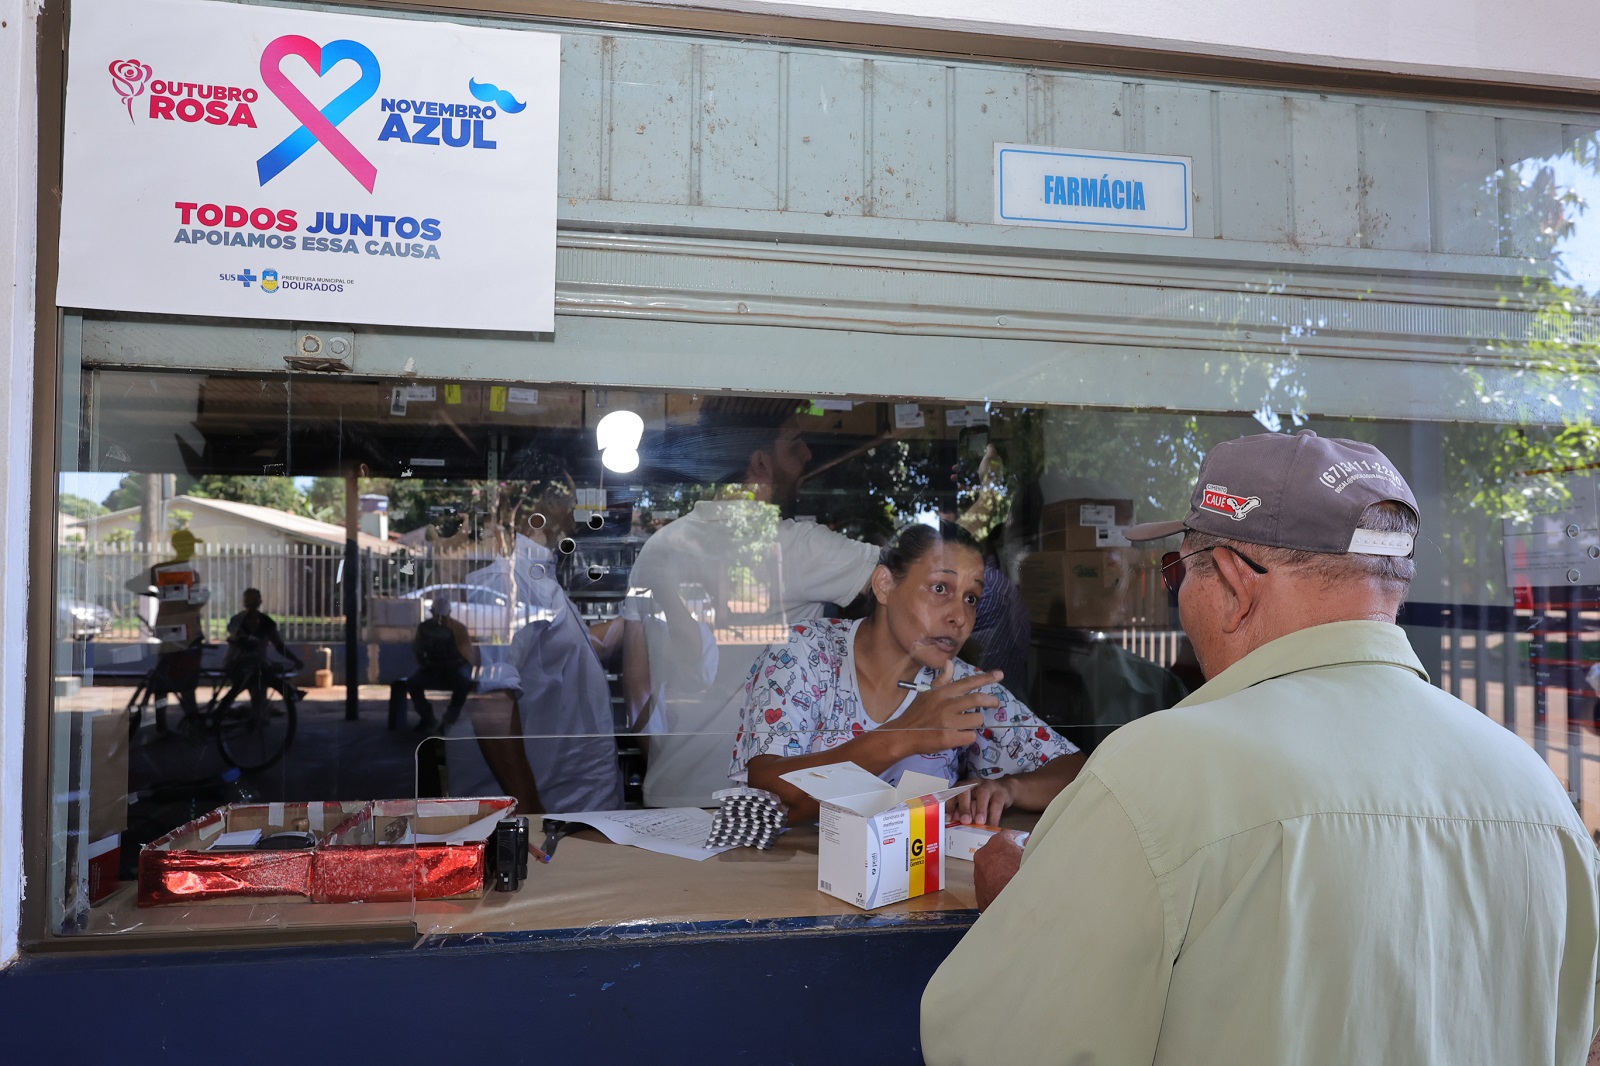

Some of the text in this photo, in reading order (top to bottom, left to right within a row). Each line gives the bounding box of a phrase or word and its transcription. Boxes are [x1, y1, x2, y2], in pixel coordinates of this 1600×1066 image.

[150, 79, 258, 103] OUTUBRO
[149, 94, 258, 128] ROSA
[381, 98, 497, 120] NOVEMBRO
[377, 113, 497, 149] AZUL
[1044, 173, 1146, 211] FARMÁCIA
[175, 201, 442, 241] TODOS JUNTOS
[174, 228, 441, 260] APOIAMOS ESSA CAUSA
[219, 273, 236, 281] SUS
[282, 281, 344, 293] DOURADOS
[317, 277, 346, 285] MUNICIPAL
[1207, 485, 1227, 493] CIMENTO
[1206, 493, 1227, 508] CAUÊ
[911, 838, 923, 856] G
